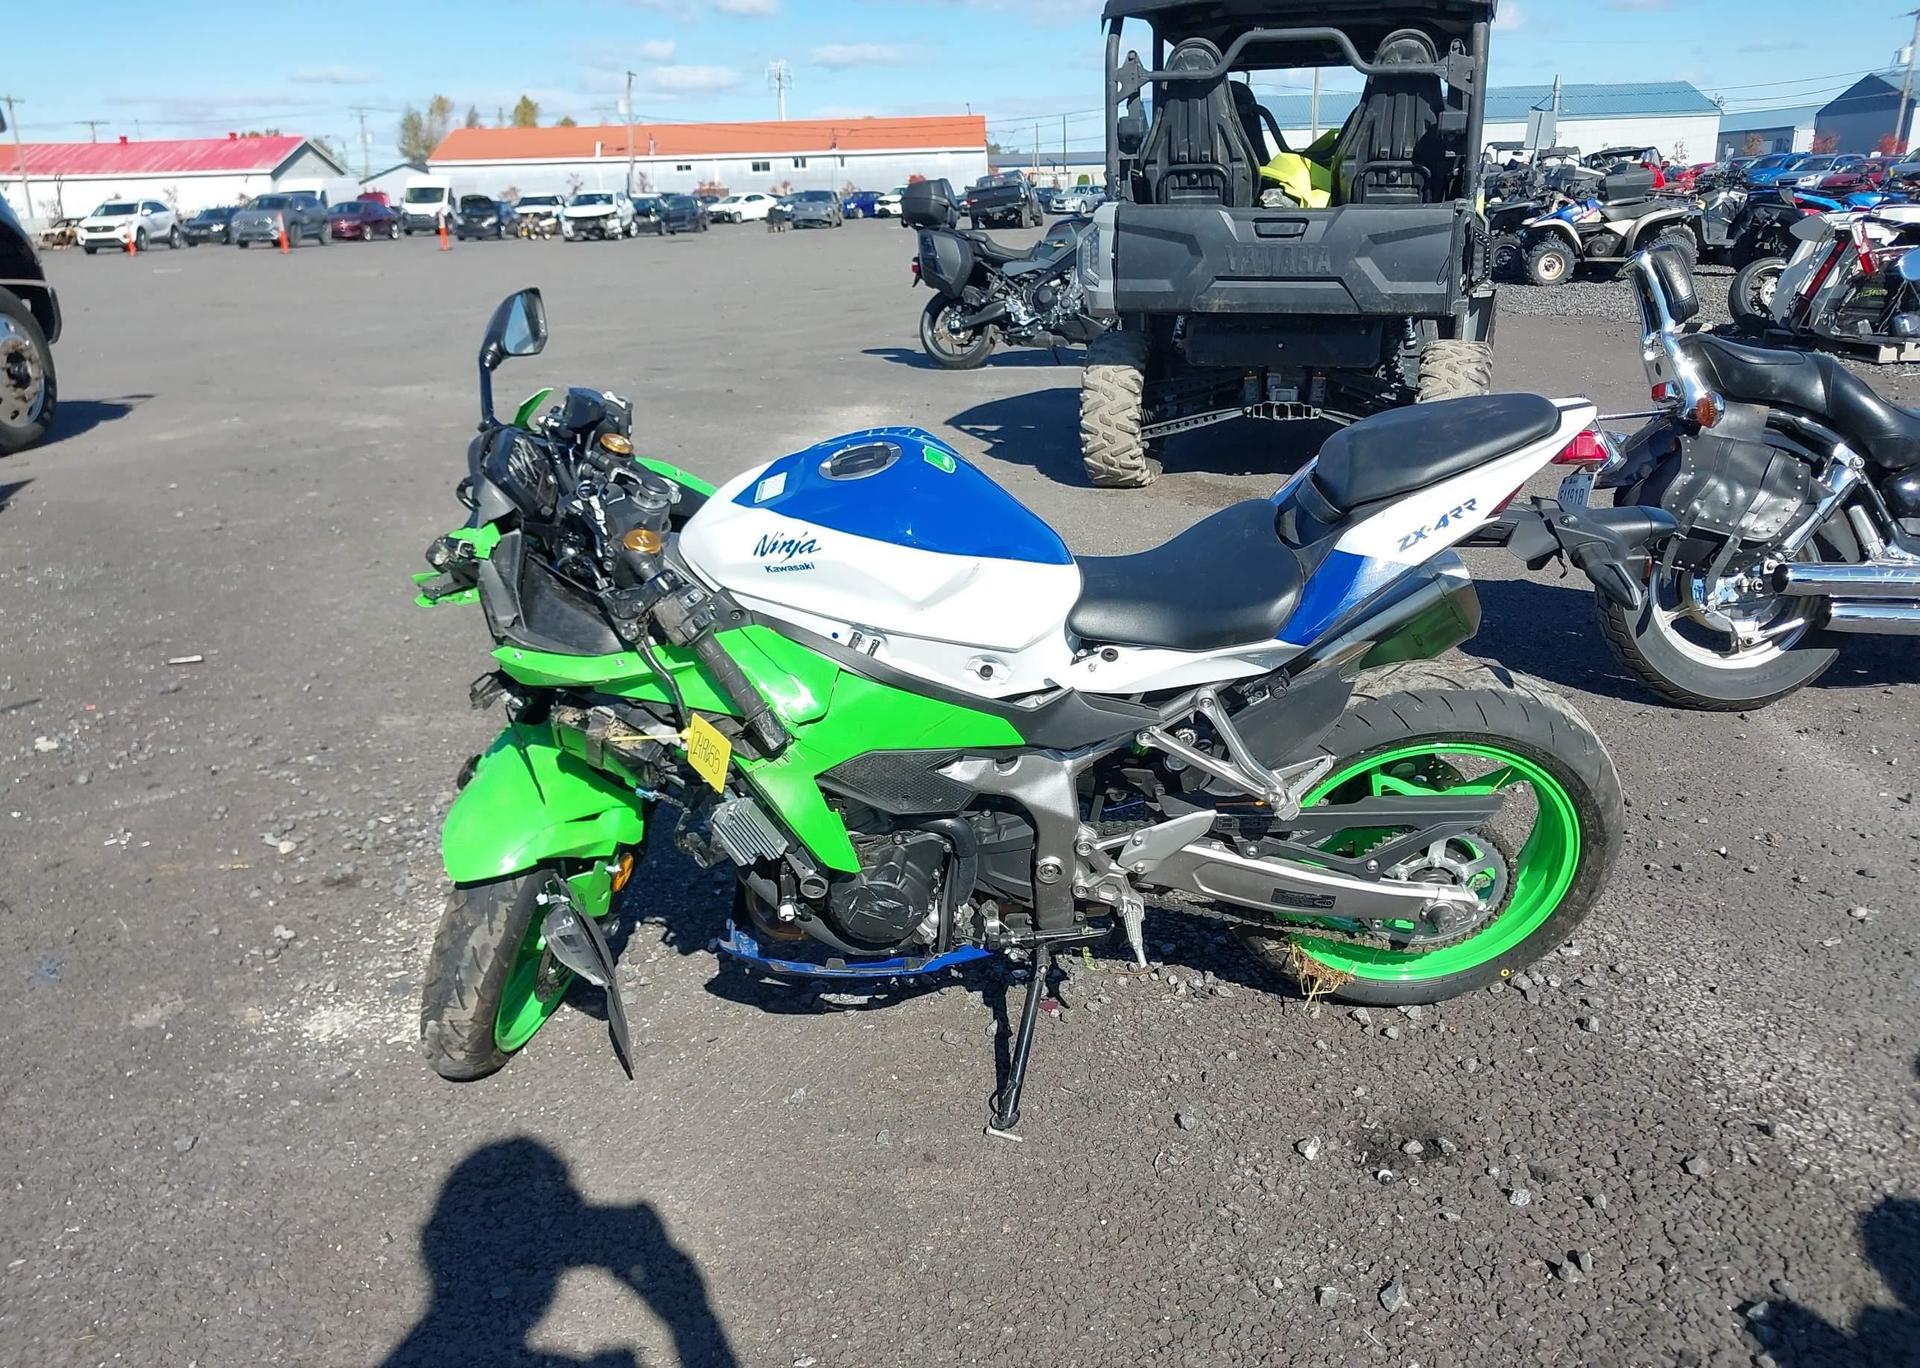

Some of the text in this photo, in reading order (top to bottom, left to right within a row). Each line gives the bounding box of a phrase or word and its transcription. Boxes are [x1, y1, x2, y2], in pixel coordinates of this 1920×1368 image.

[1224, 244, 1332, 275] YAMAHA
[1396, 497, 1478, 552] ZX-4RR
[753, 531, 822, 564] Ninja
[764, 561, 816, 574] Kawasaki
